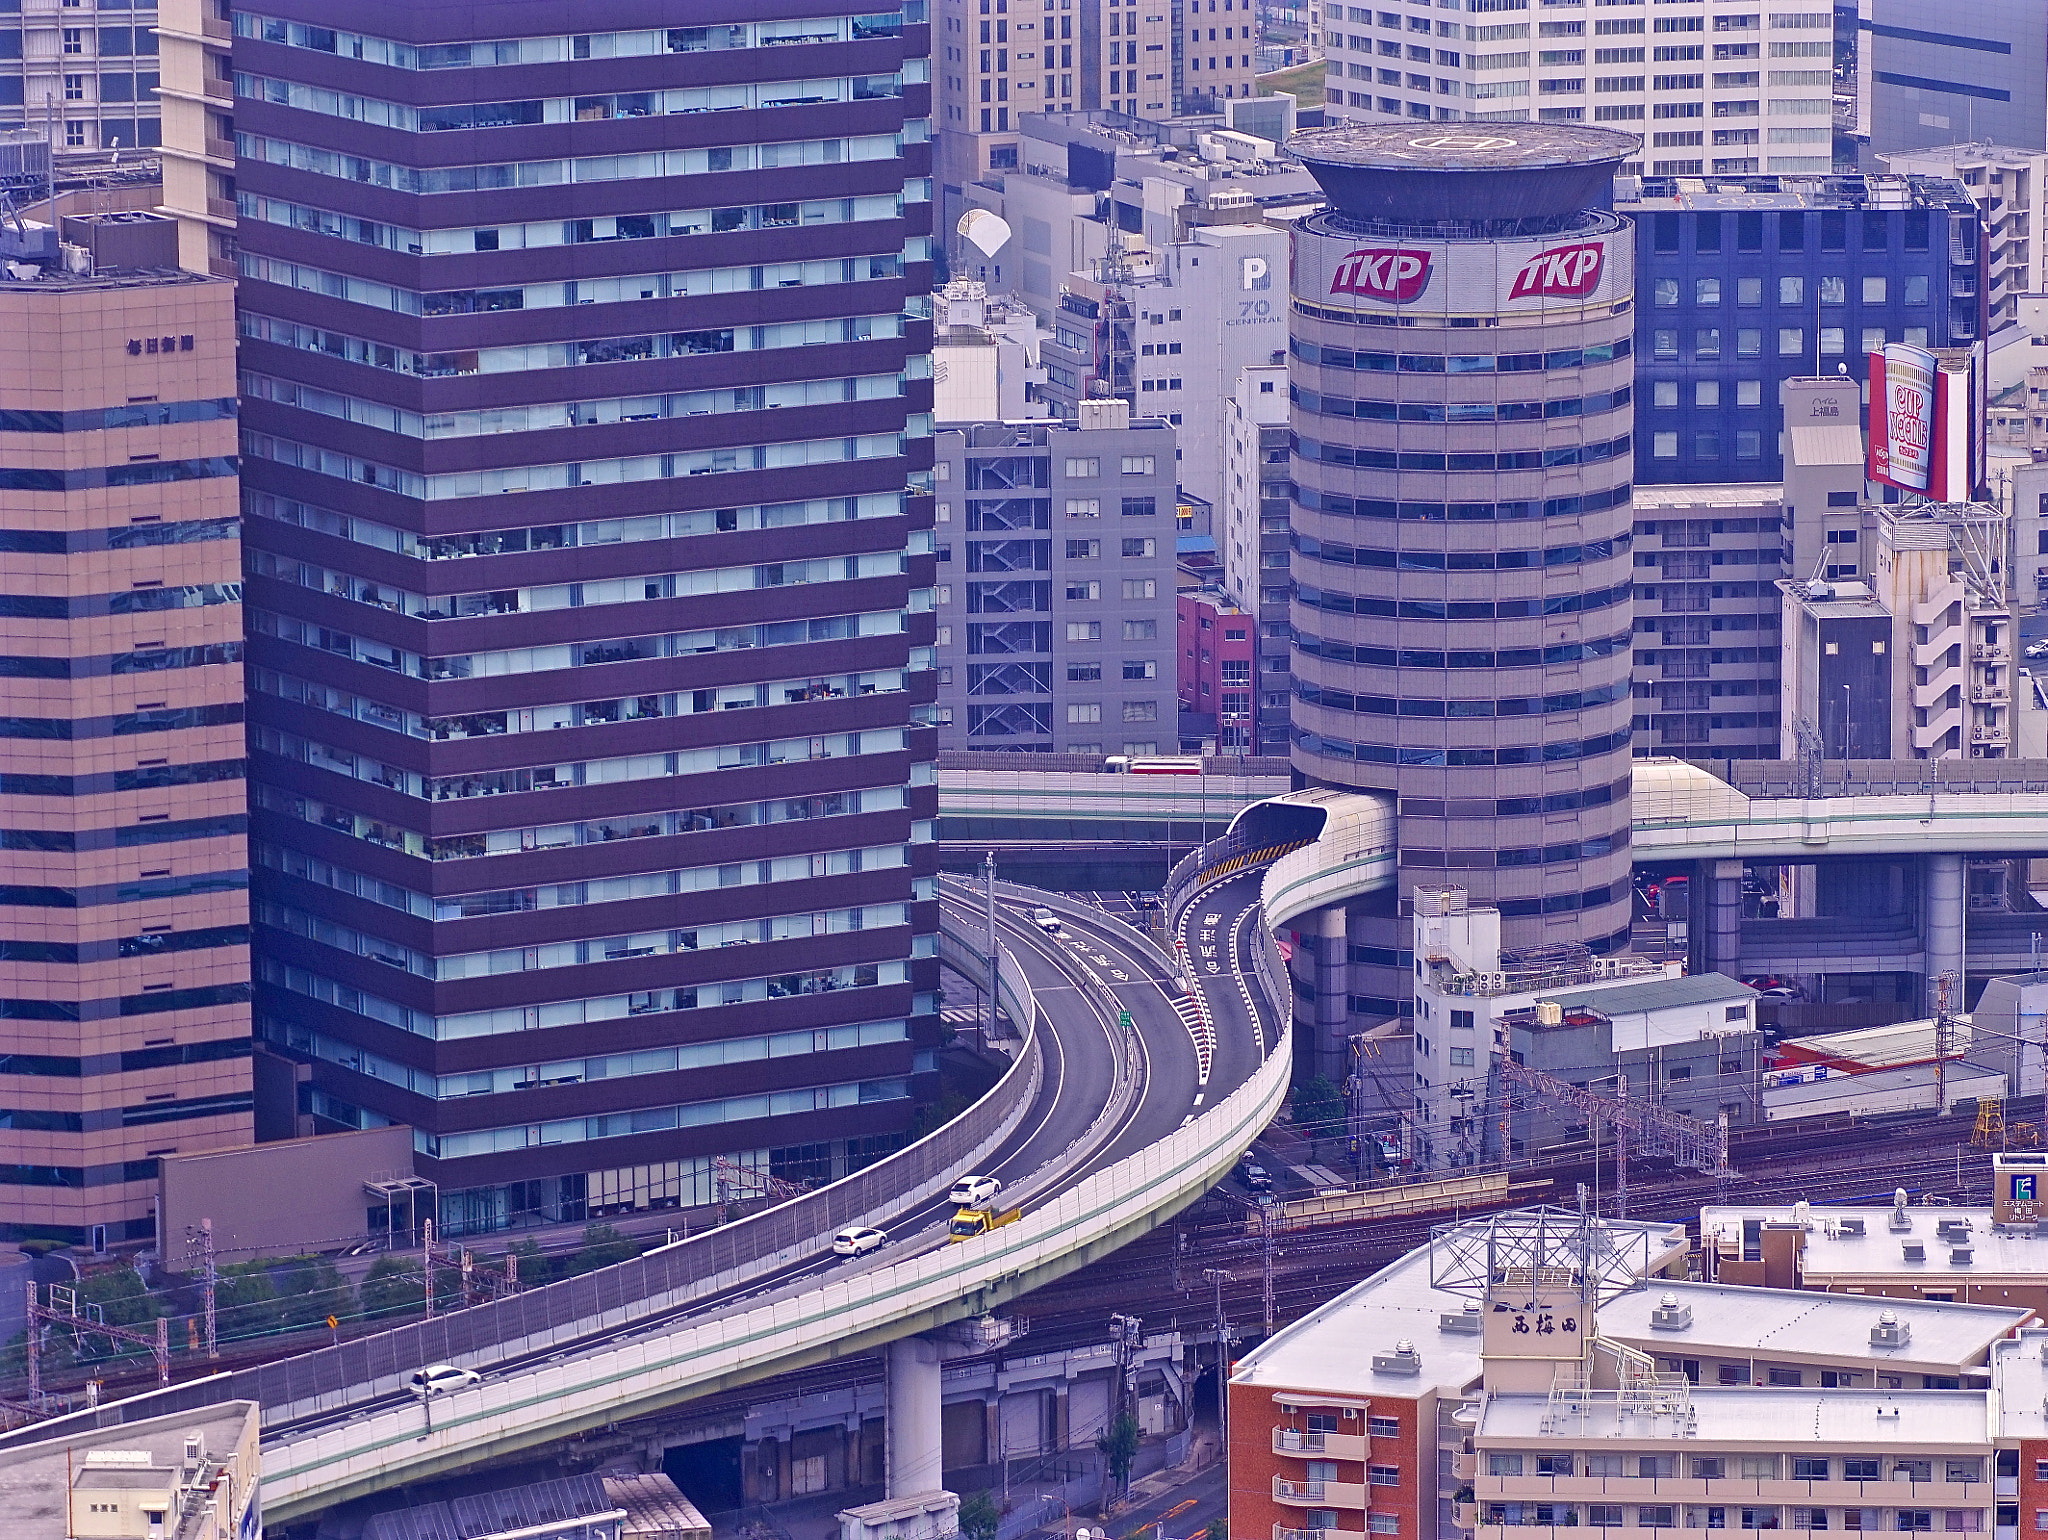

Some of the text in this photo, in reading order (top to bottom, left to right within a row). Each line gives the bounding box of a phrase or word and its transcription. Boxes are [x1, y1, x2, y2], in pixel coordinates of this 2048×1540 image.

[1243, 257, 1268, 290] P
[1338, 254, 1422, 291] TKP
[1521, 249, 1599, 291] TKP
[1225, 315, 1282, 326] CENTRAL
[1238, 299, 1270, 317] 70
[1894, 384, 1924, 418] CUP
[1888, 410, 1928, 450] NOODLE
[1199, 912, 1222, 974] 合流注意
[2002, 1200, 2045, 1208] エステムコート
[1511, 1313, 1577, 1336] 西梅田
